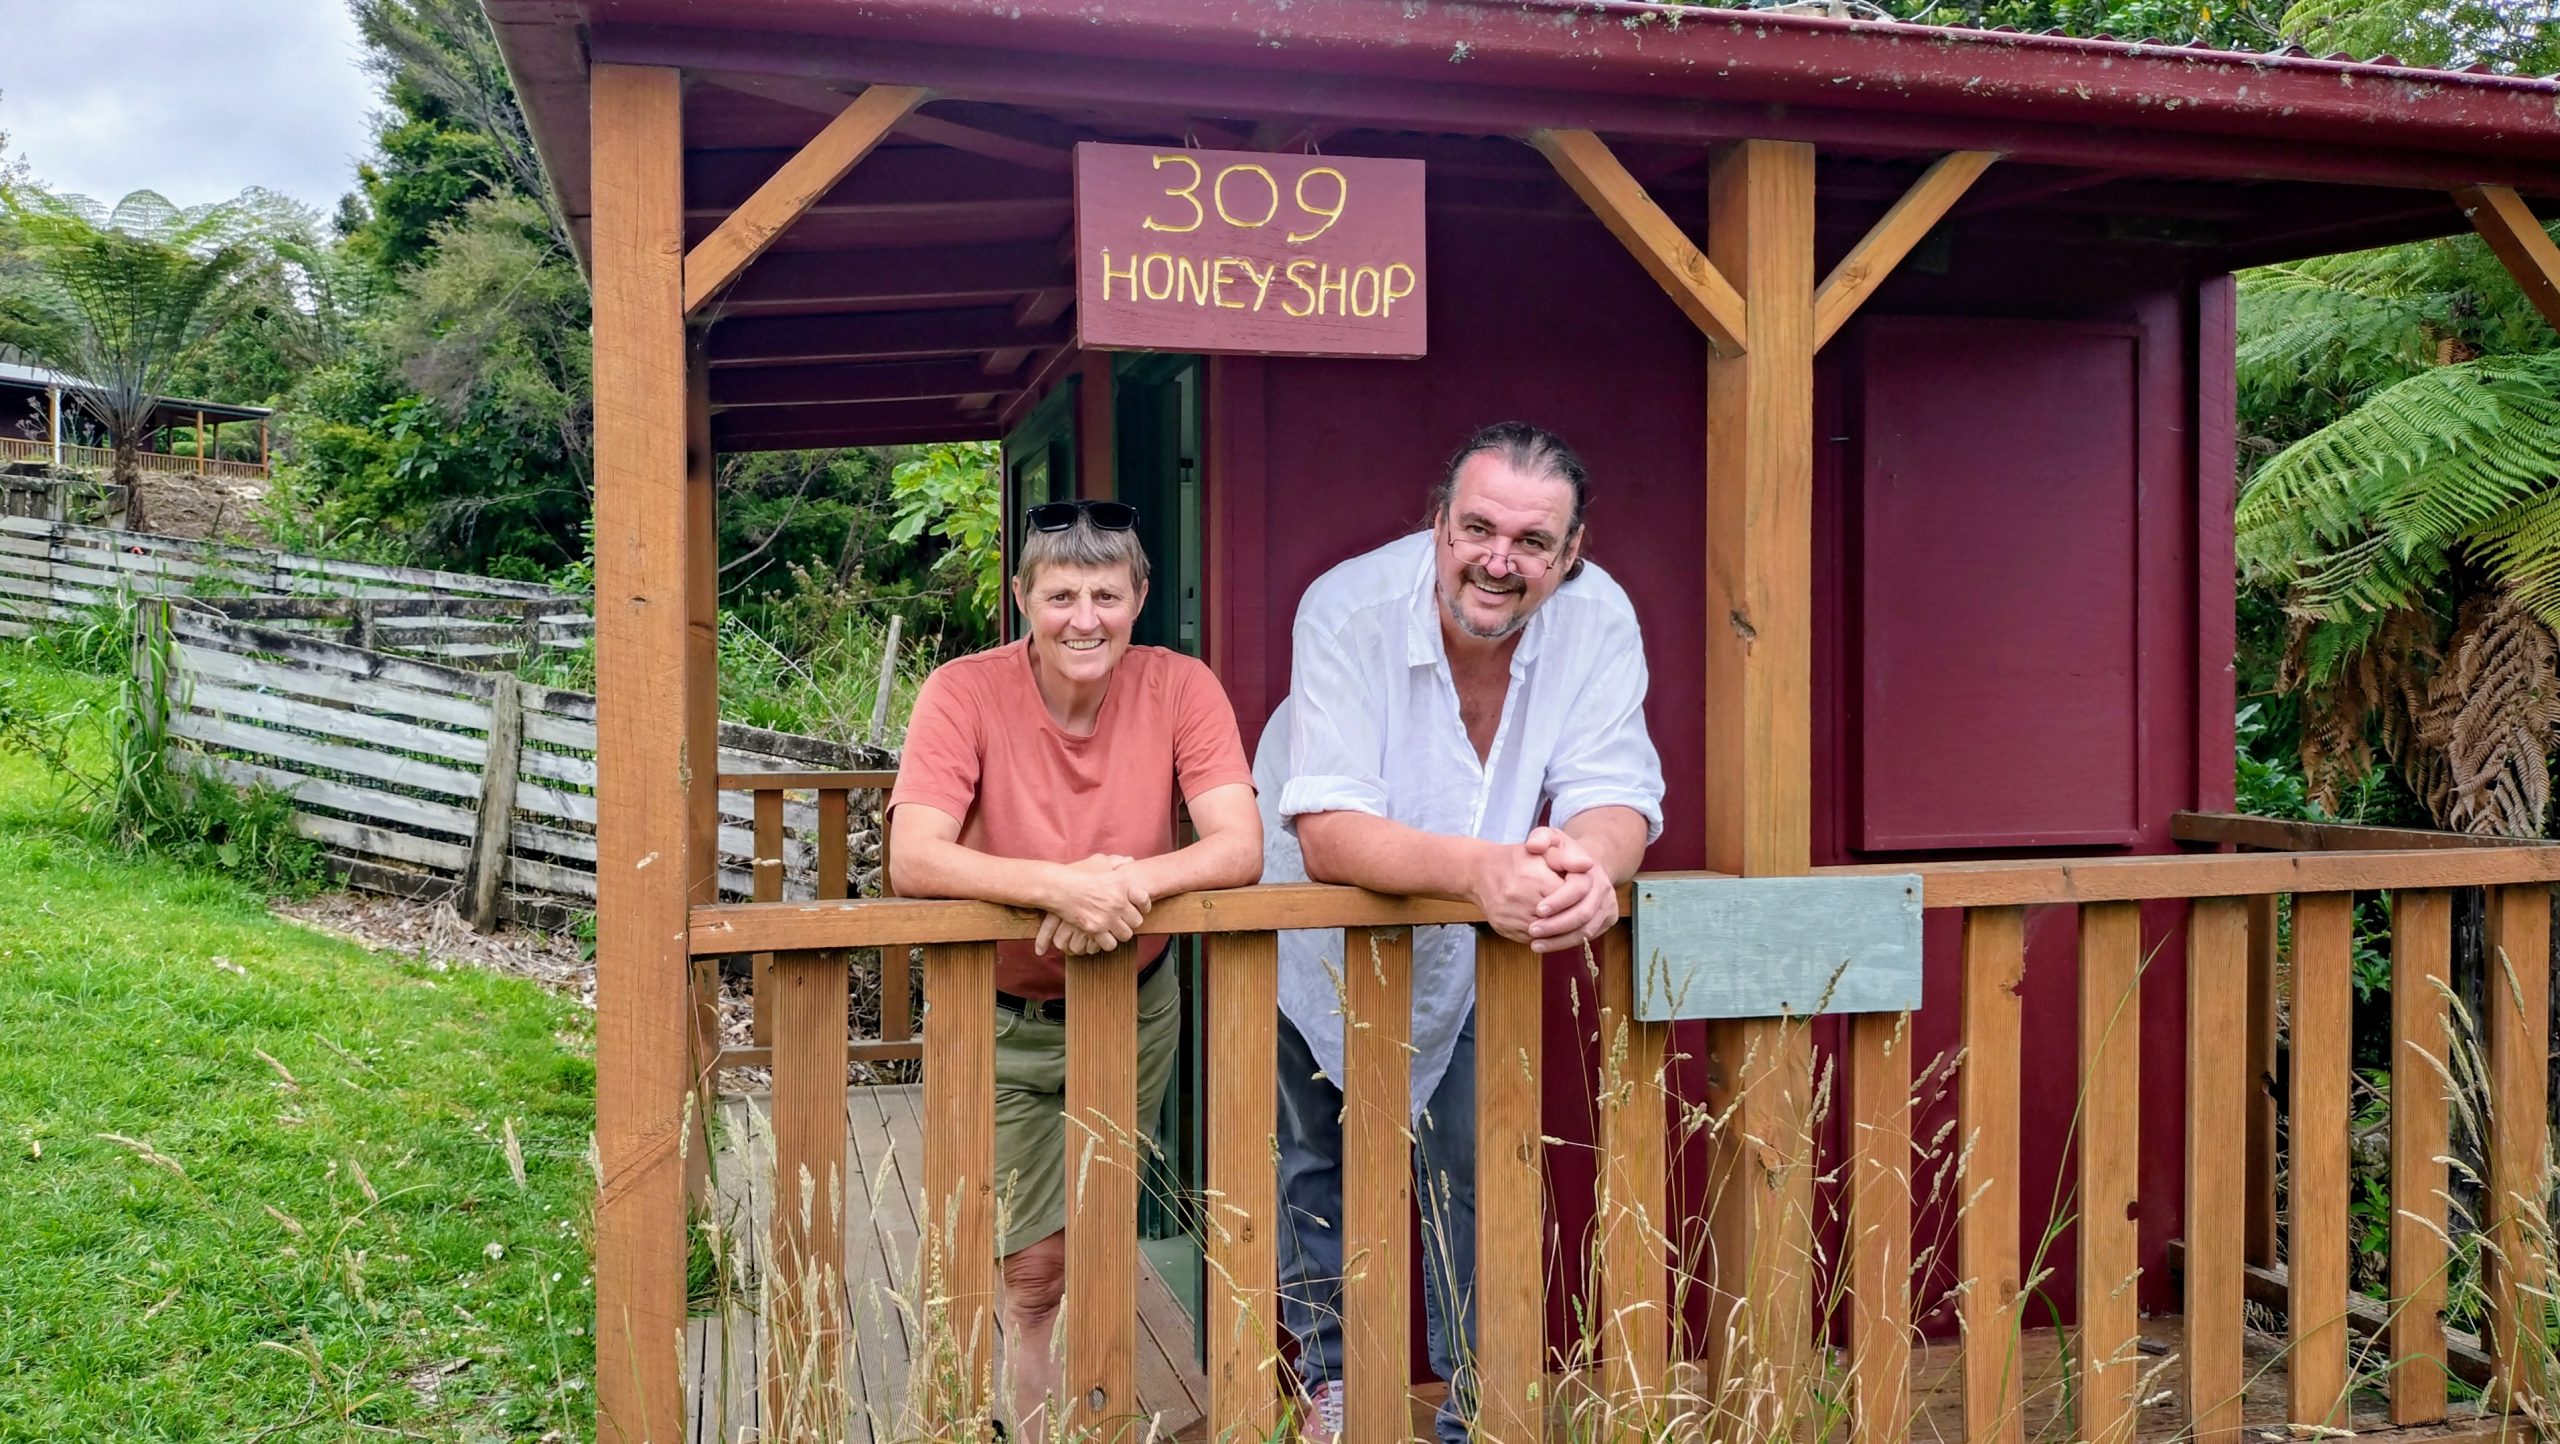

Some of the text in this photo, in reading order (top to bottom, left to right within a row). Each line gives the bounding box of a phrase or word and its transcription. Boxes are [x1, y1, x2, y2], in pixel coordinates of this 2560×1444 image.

[1142, 154, 1348, 243] 309
[1101, 250, 1416, 318] HONEY SHOP
